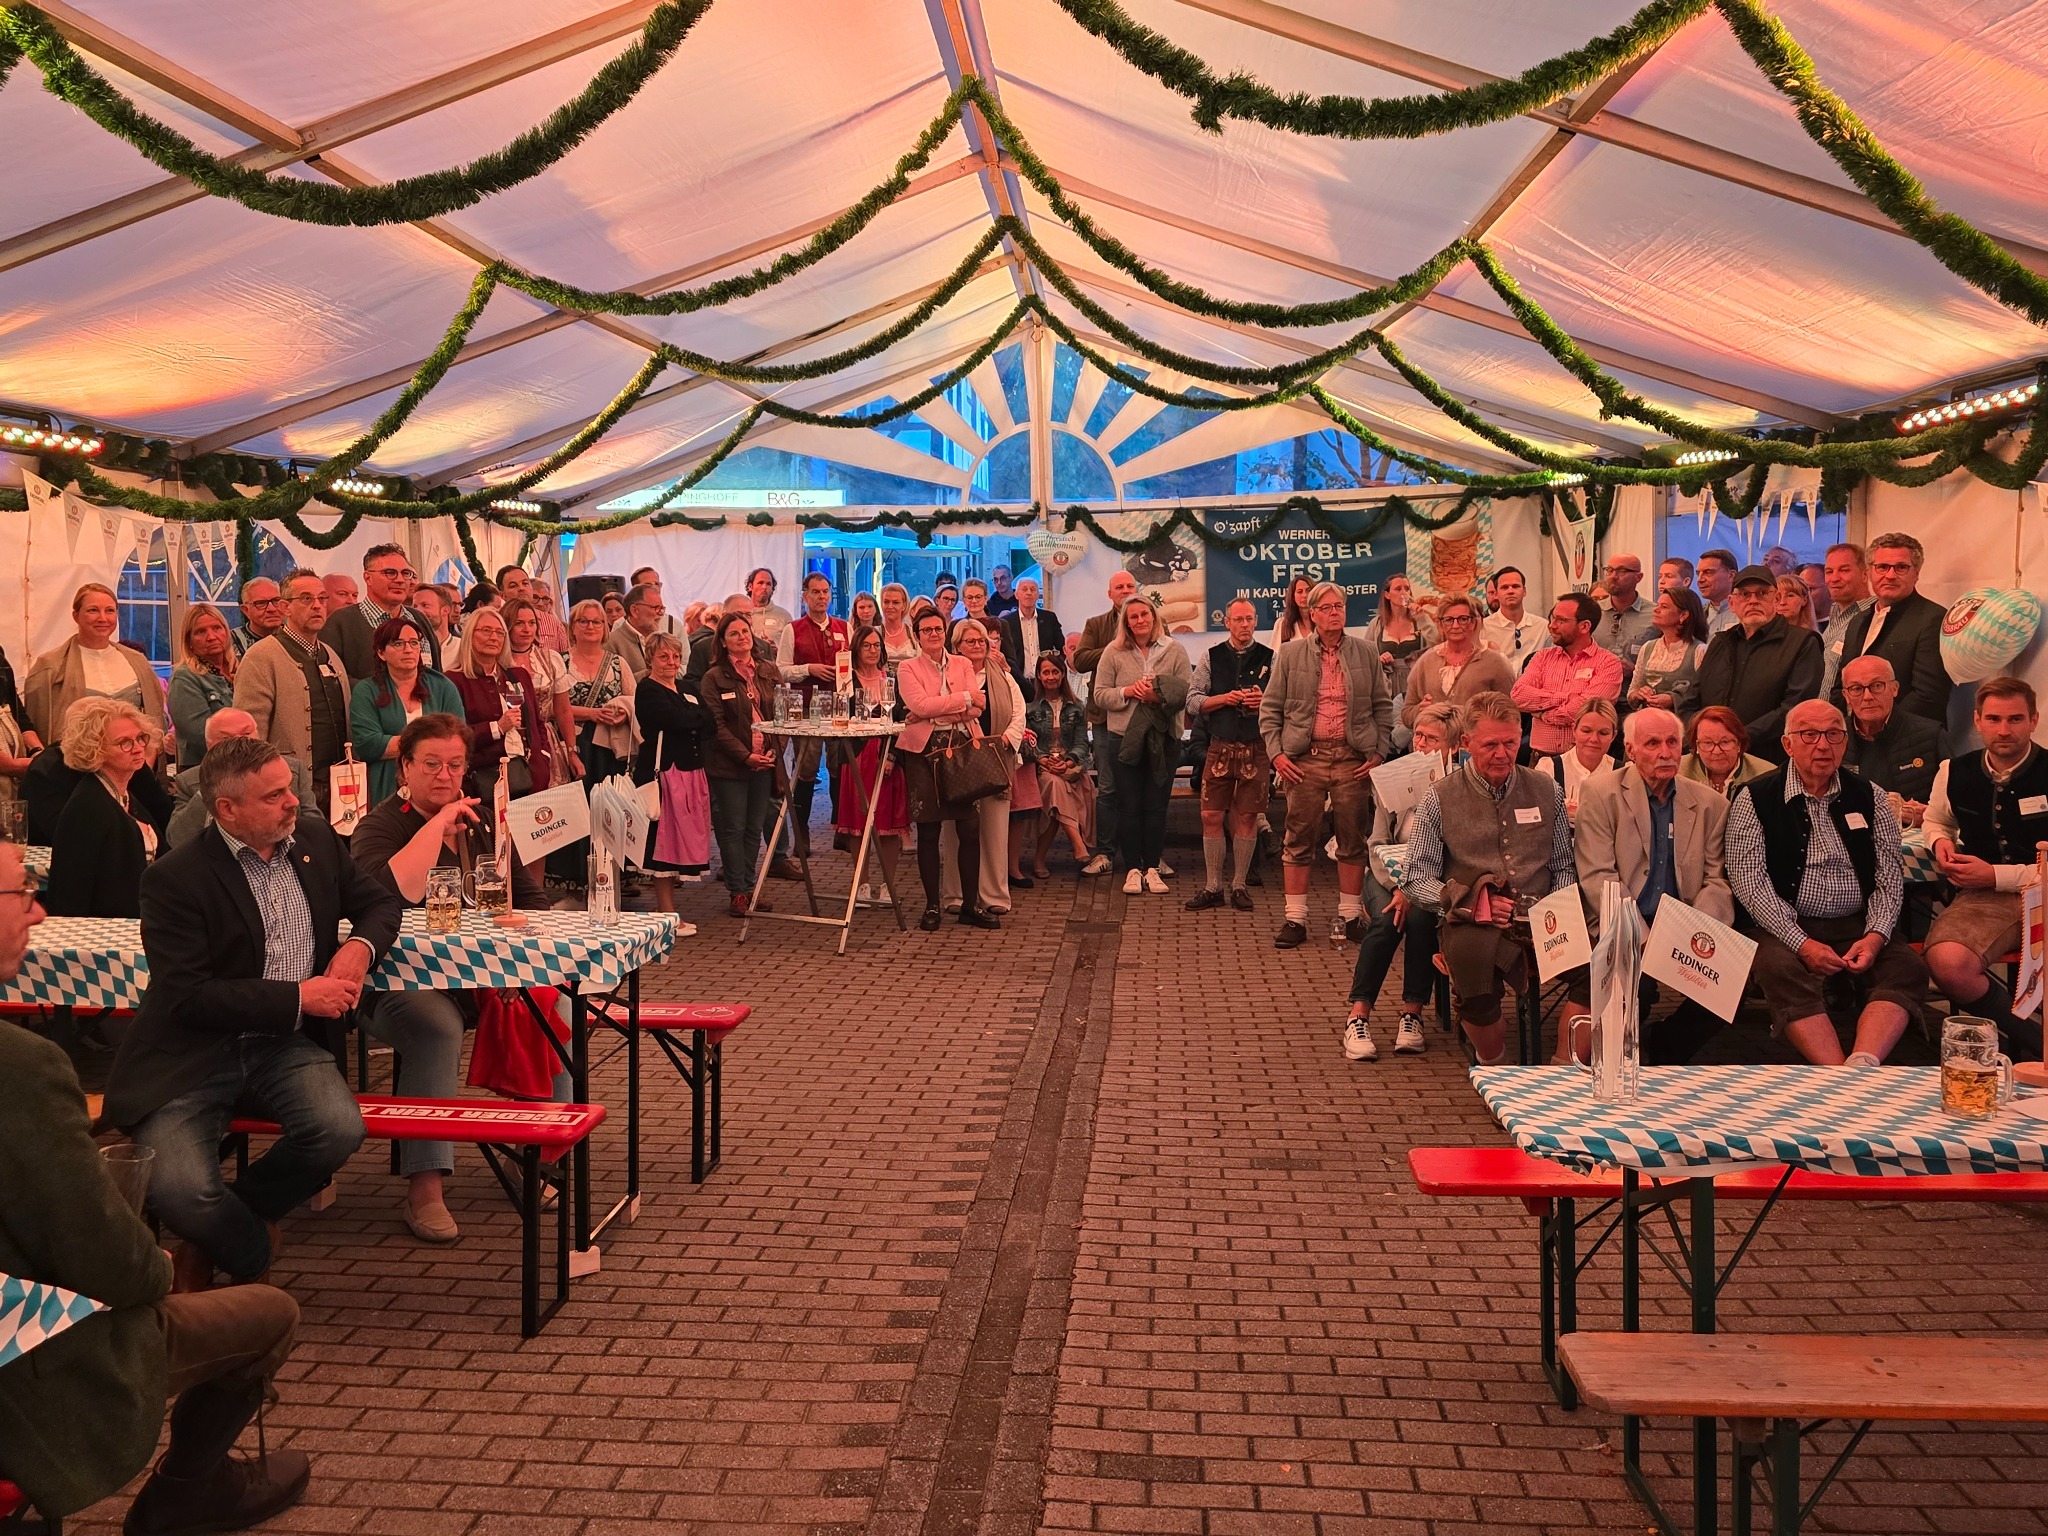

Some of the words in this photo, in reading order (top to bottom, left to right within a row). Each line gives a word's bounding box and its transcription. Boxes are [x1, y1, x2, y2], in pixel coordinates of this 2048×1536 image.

[768, 492, 800, 506] B&G
[1238, 542, 1373, 561] OKTOBER
[1272, 562, 1341, 583] FEST
[1236, 588, 1250, 599] IM
[530, 818, 569, 841] ERDINGER
[1543, 932, 1569, 952] ERDINGER
[1671, 947, 1720, 986] ERDINGER
[379, 1107, 455, 1118] KEIN
[459, 1110, 574, 1123] WIEDER
